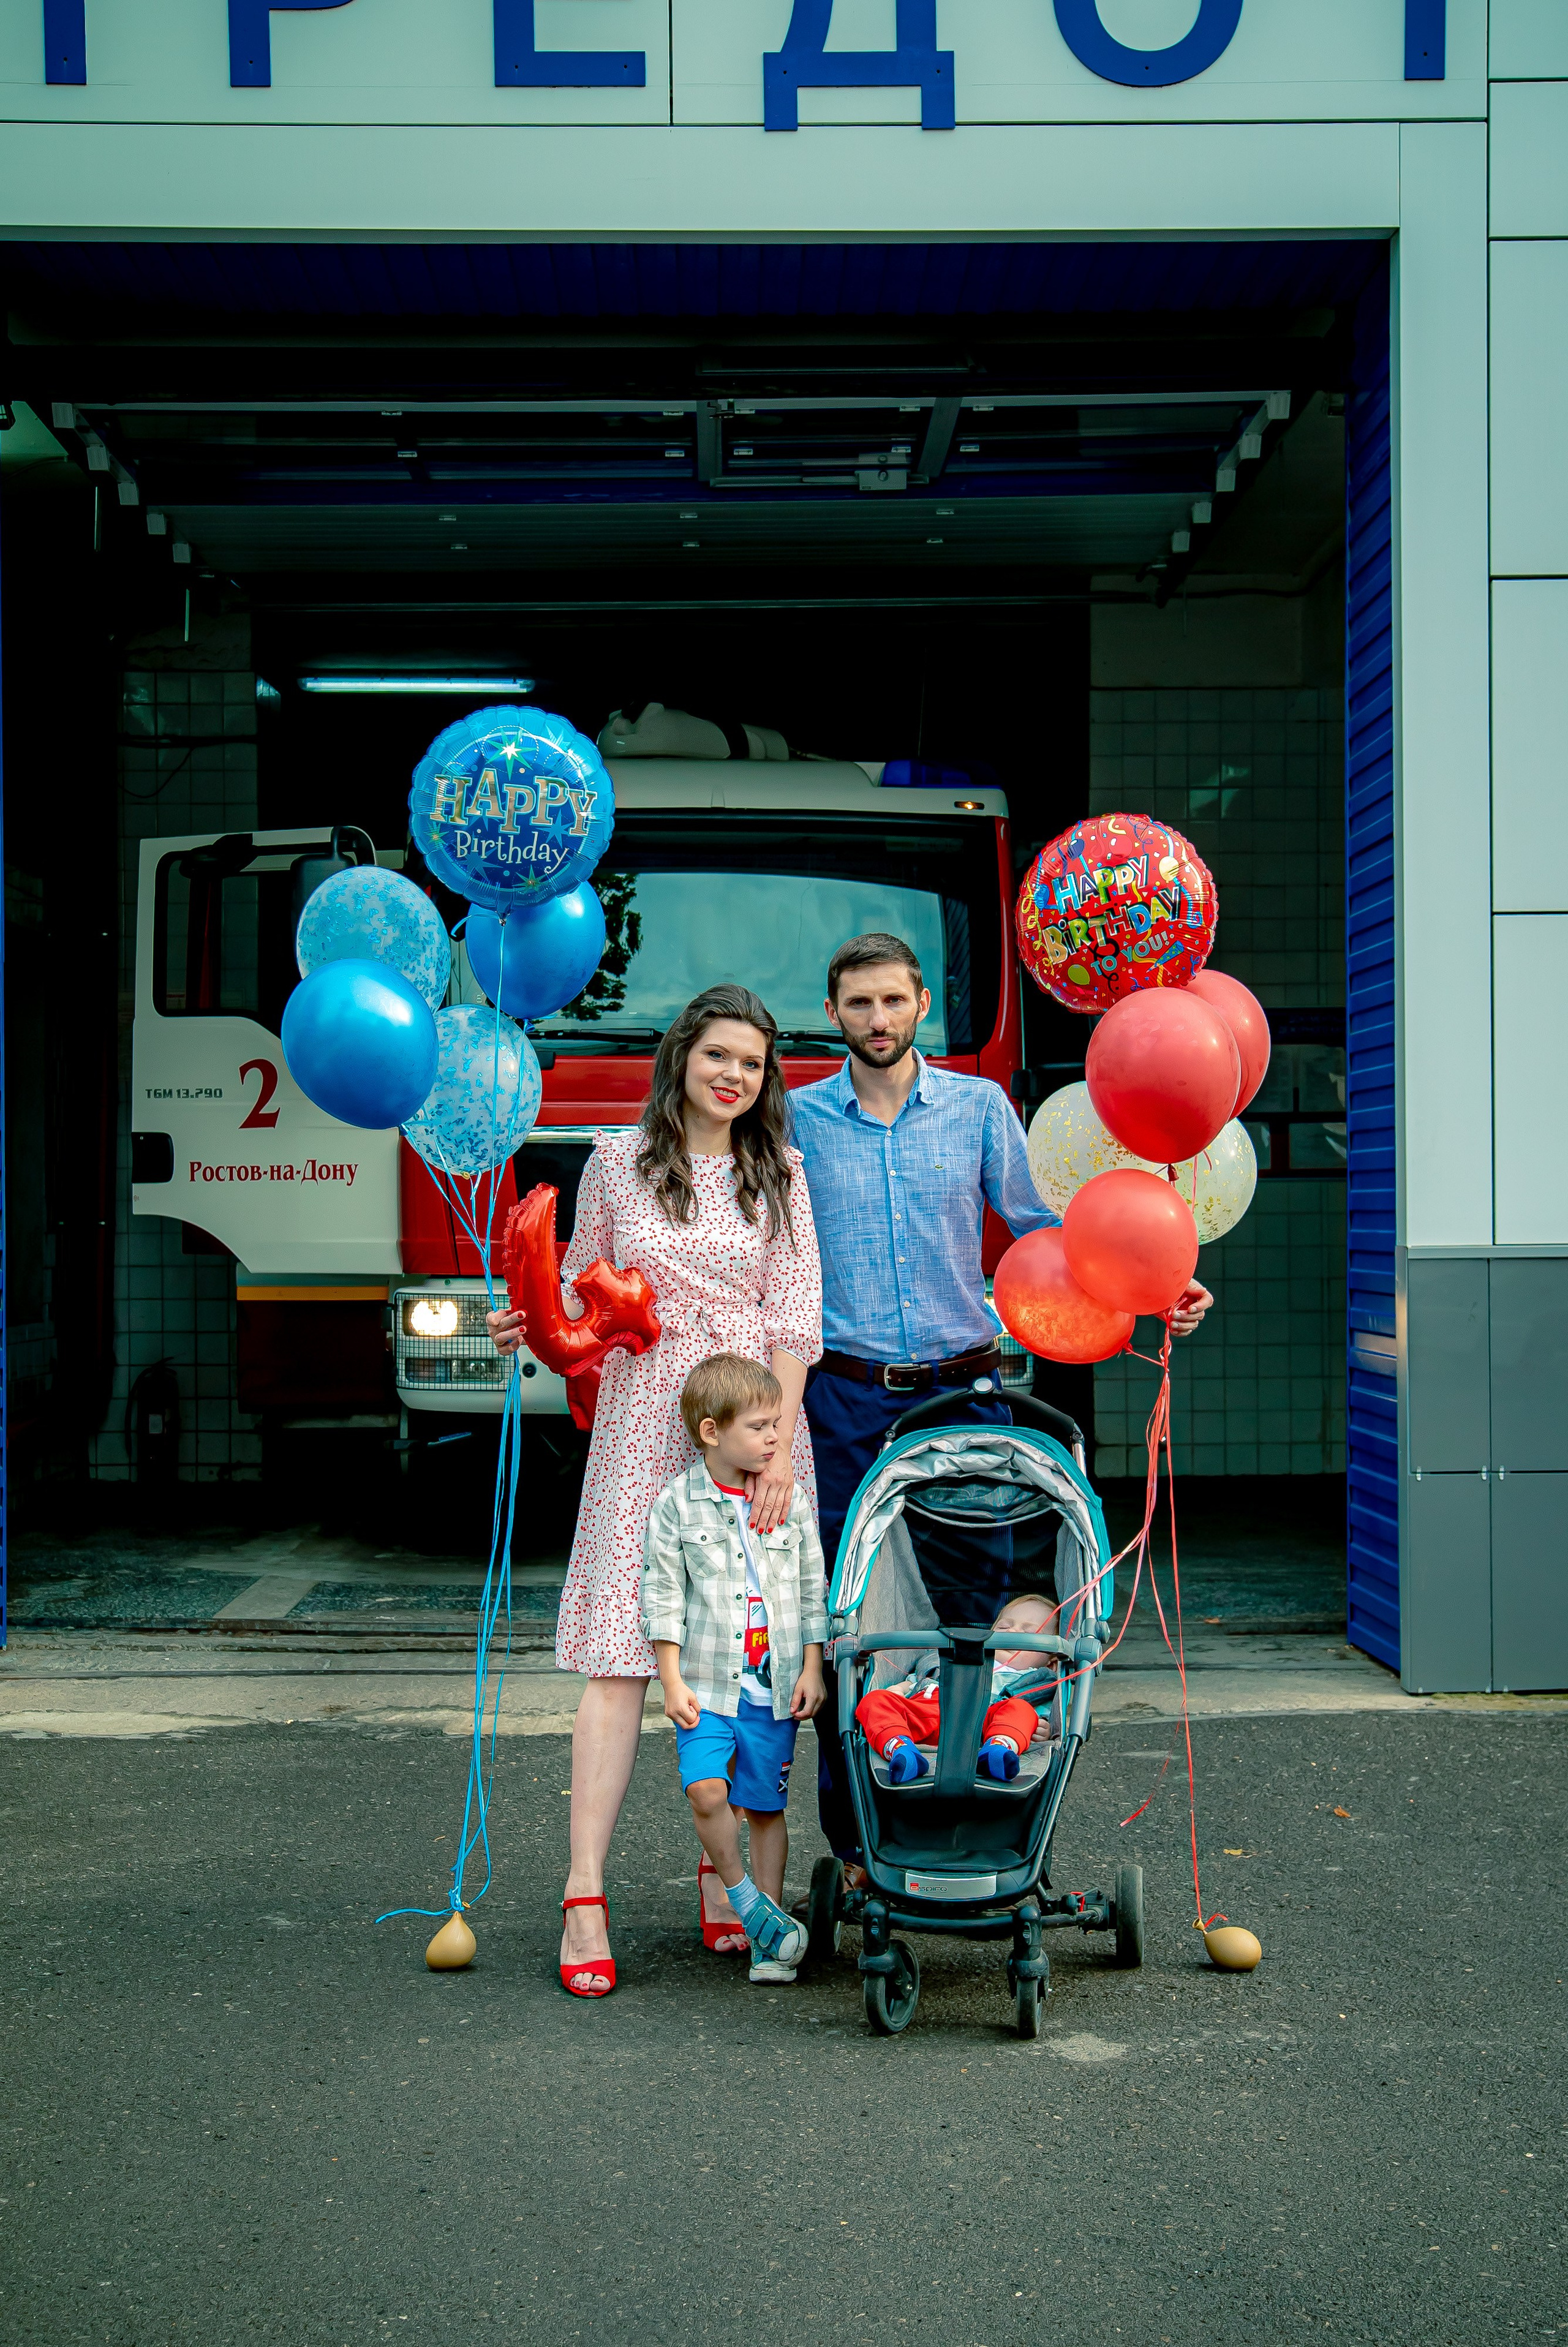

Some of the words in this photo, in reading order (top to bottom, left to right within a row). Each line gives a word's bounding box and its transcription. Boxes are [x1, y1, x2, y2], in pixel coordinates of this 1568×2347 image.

[430, 767, 598, 836] HAPPY
[455, 828, 569, 875] Birthday
[1052, 854, 1150, 916] HAPPY
[1090, 954, 1118, 976] TO
[1120, 930, 1169, 963] YOU!
[145, 1088, 173, 1099] TGM
[238, 1058, 281, 1129] 2
[189, 1159, 359, 1186] Ростов-на-Дону
[910, 1882, 948, 1892] espiro
